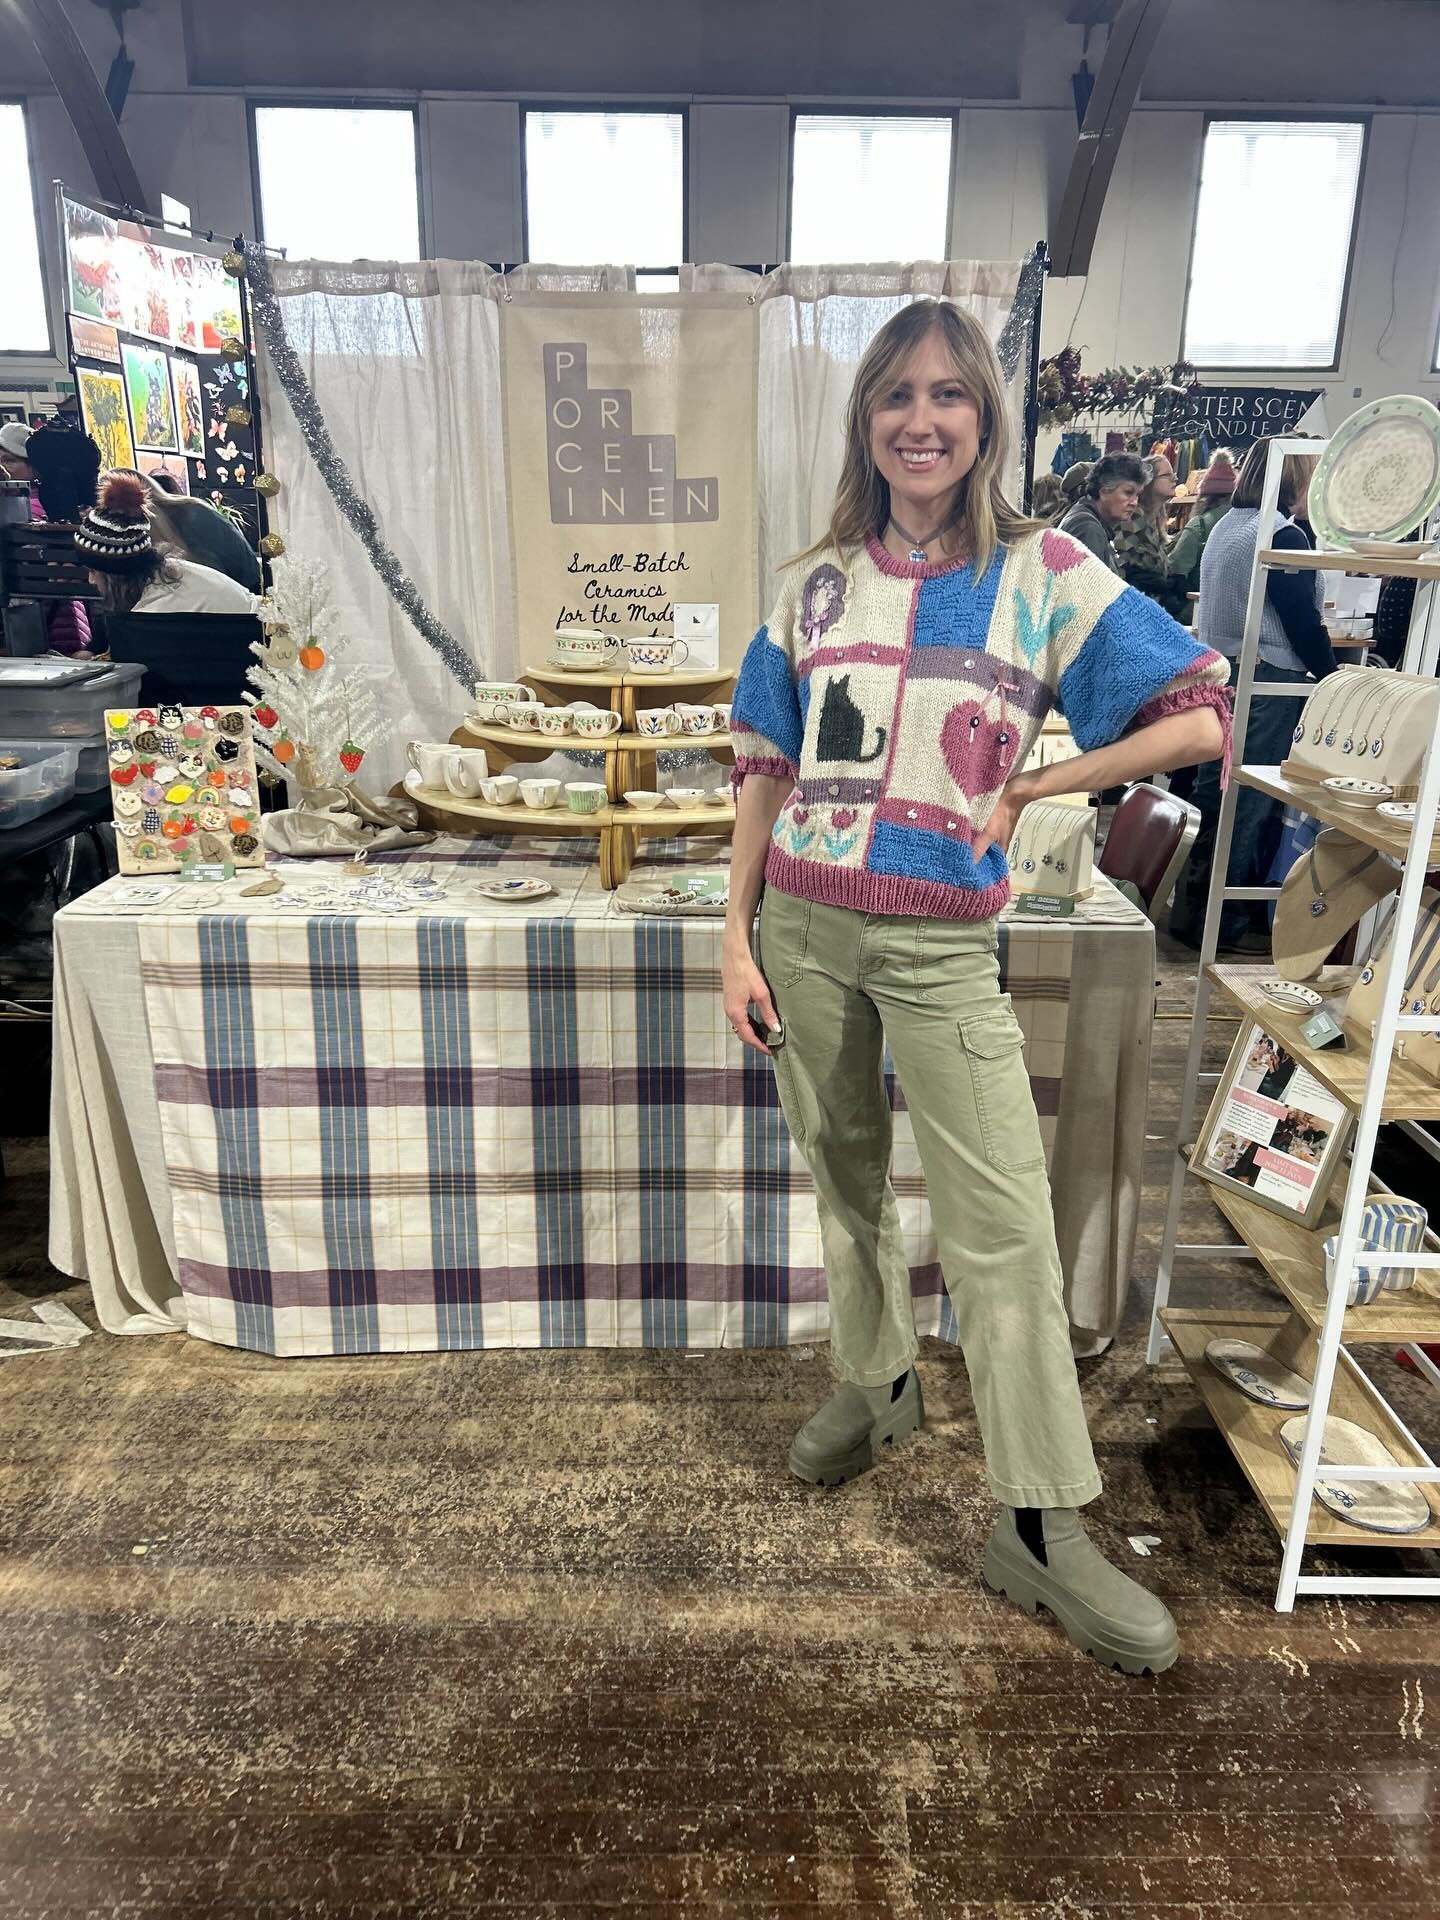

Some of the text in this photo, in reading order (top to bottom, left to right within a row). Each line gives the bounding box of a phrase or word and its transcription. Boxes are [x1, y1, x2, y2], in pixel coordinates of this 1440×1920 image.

[1252, 397, 1310, 420] SCEN
[1184, 418, 1294, 439] CANDLE C
[567, 551, 690, 574] Small-Batch
[584, 580, 668, 600] Ceramics
[555, 602, 675, 630] for the Mode
